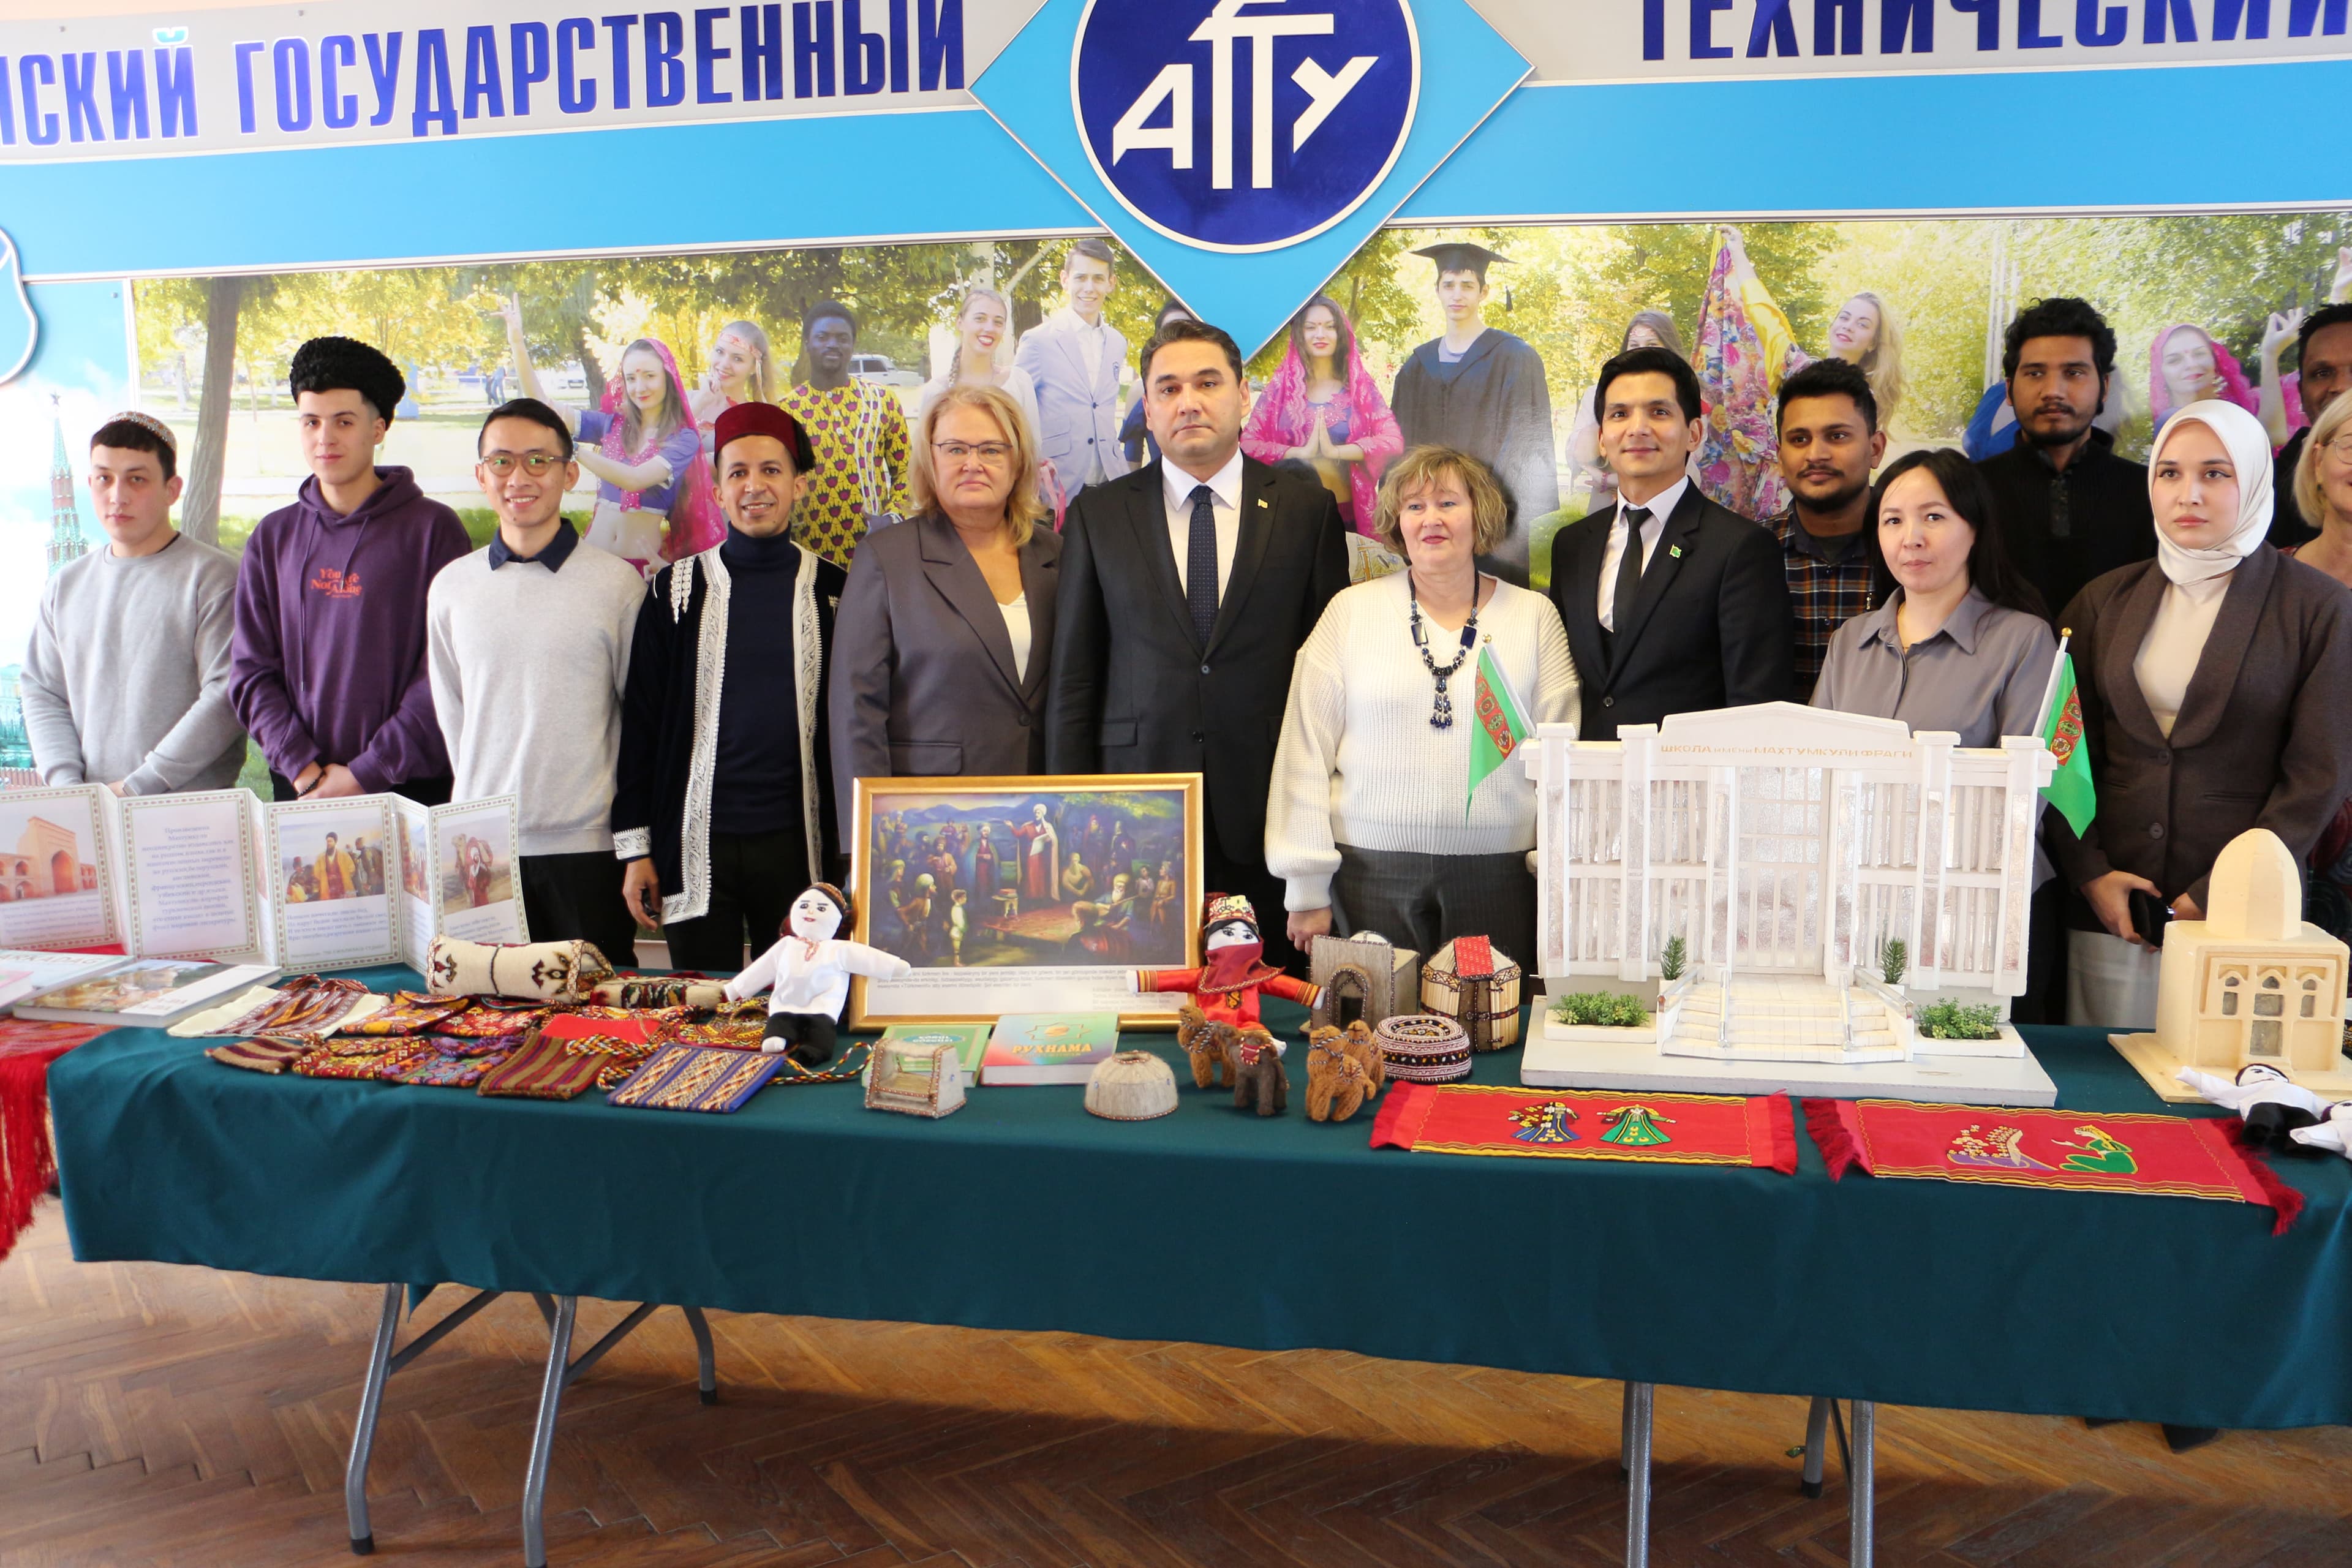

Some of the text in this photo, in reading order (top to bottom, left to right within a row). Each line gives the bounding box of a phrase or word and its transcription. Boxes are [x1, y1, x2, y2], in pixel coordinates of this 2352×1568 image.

[0, 28, 199, 146] СКИЙ
[1660, 744, 1712, 753] ШКОЛА
[1754, 746, 1858, 758] МАХТУМКУЛИ
[1861, 749, 1913, 759] ФРАГИ
[1012, 1042, 1093, 1054] РУХНАМА
